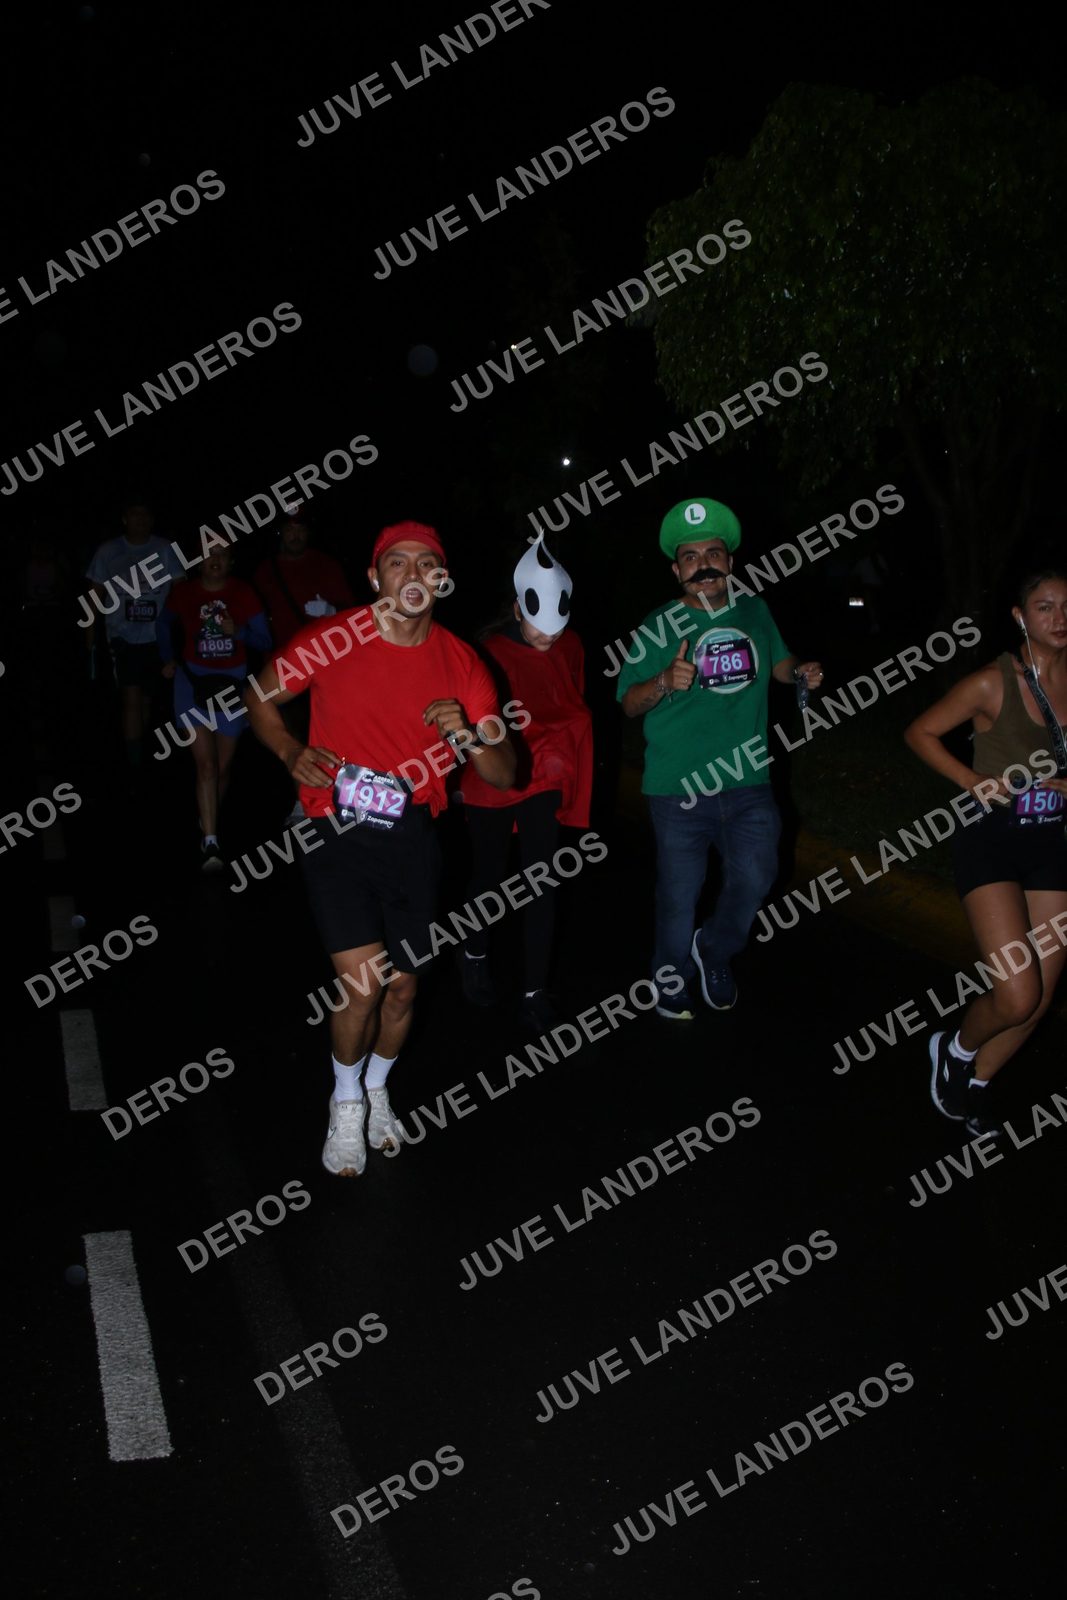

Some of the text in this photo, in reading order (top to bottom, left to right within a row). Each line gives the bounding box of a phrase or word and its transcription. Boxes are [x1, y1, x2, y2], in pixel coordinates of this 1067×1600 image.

[690, 508, 701, 521] L
[200, 638, 233, 651] 1805
[708, 652, 743, 674] 786
[345, 781, 405, 816] 1912
